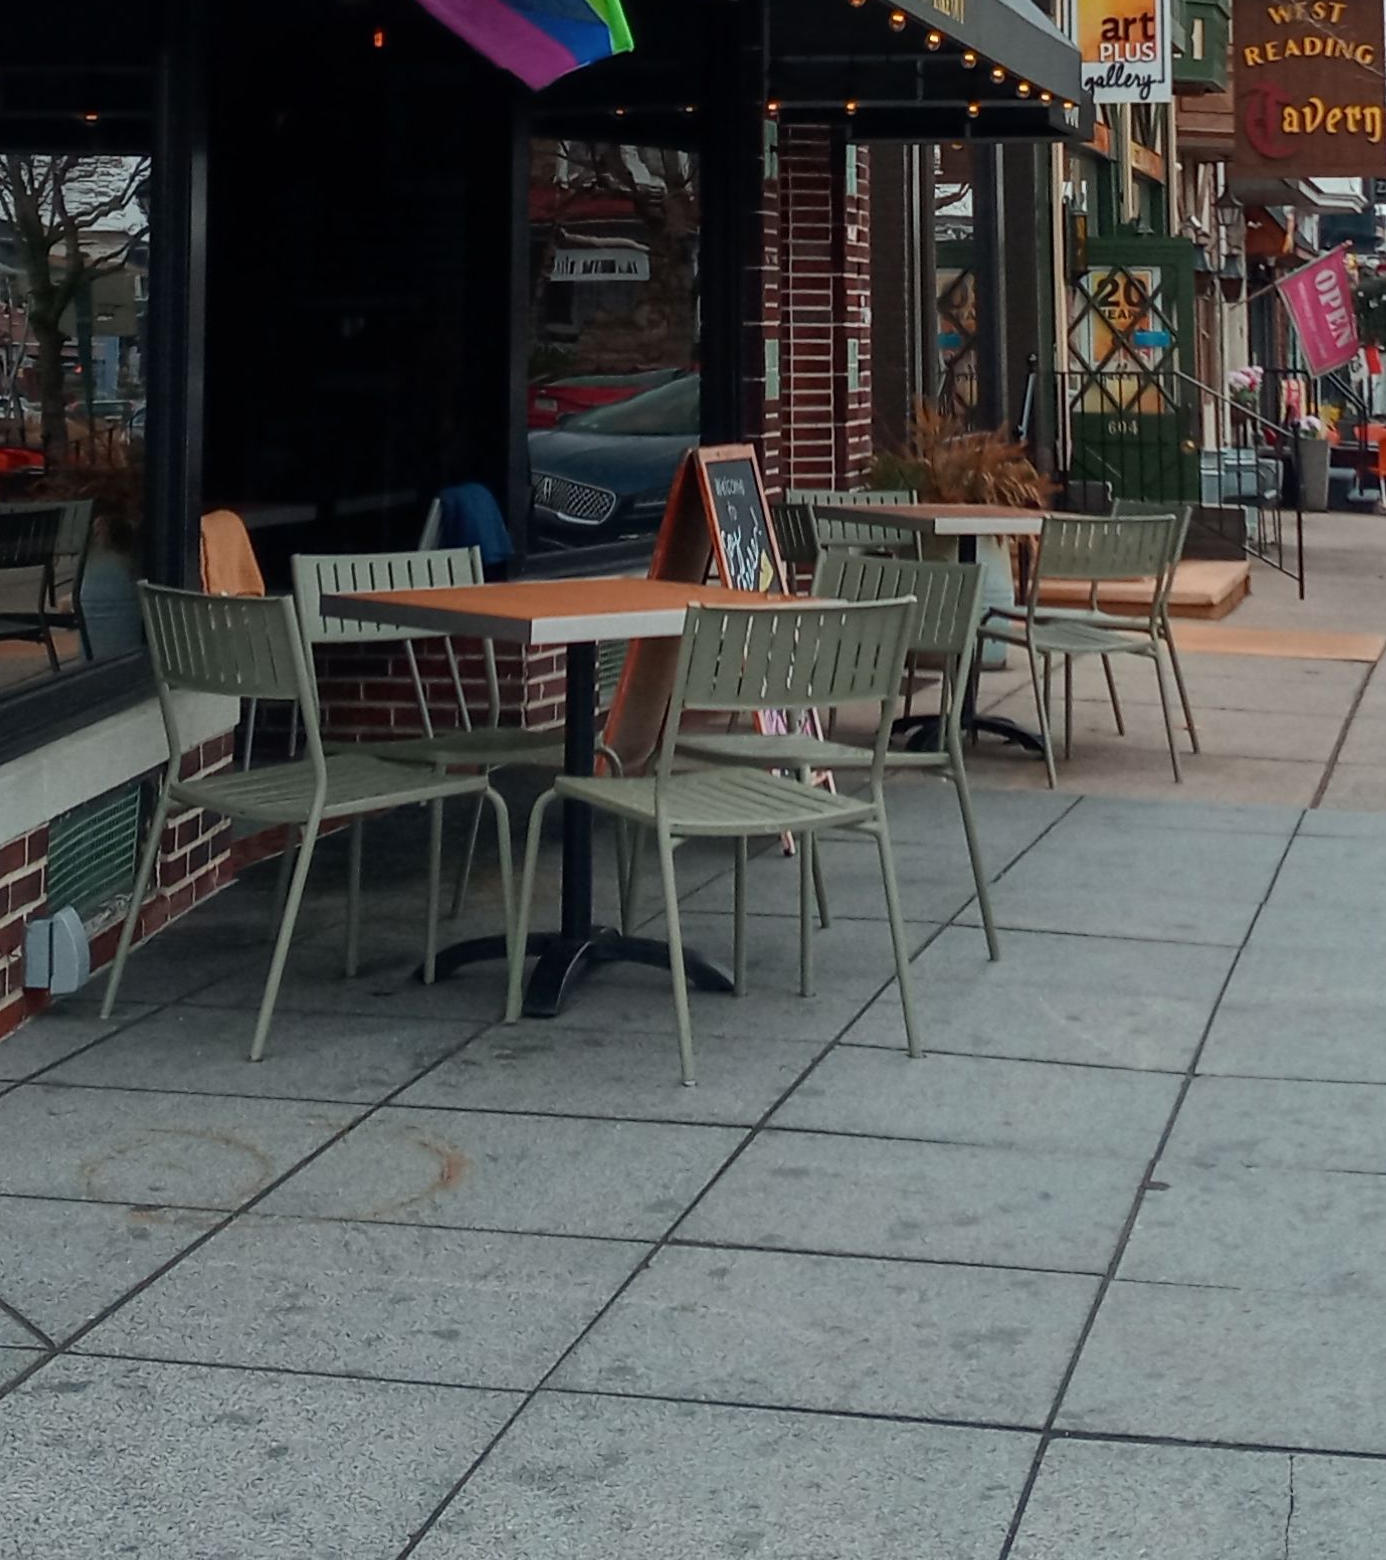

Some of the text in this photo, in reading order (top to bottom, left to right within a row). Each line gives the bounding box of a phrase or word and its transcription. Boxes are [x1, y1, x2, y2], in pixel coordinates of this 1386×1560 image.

[1100, 11, 1156, 42] art
[1267, 1, 1349, 25] WEST
[1098, 42, 1156, 62] PLUS
[1244, 37, 1375, 67] READING
[1084, 62, 1154, 101] gallery
[1245, 78, 1383, 159] Tavern
[1096, 278, 1150, 308] 20
[1314, 269, 1353, 349] OPEN
[1107, 419, 1139, 436] 604
